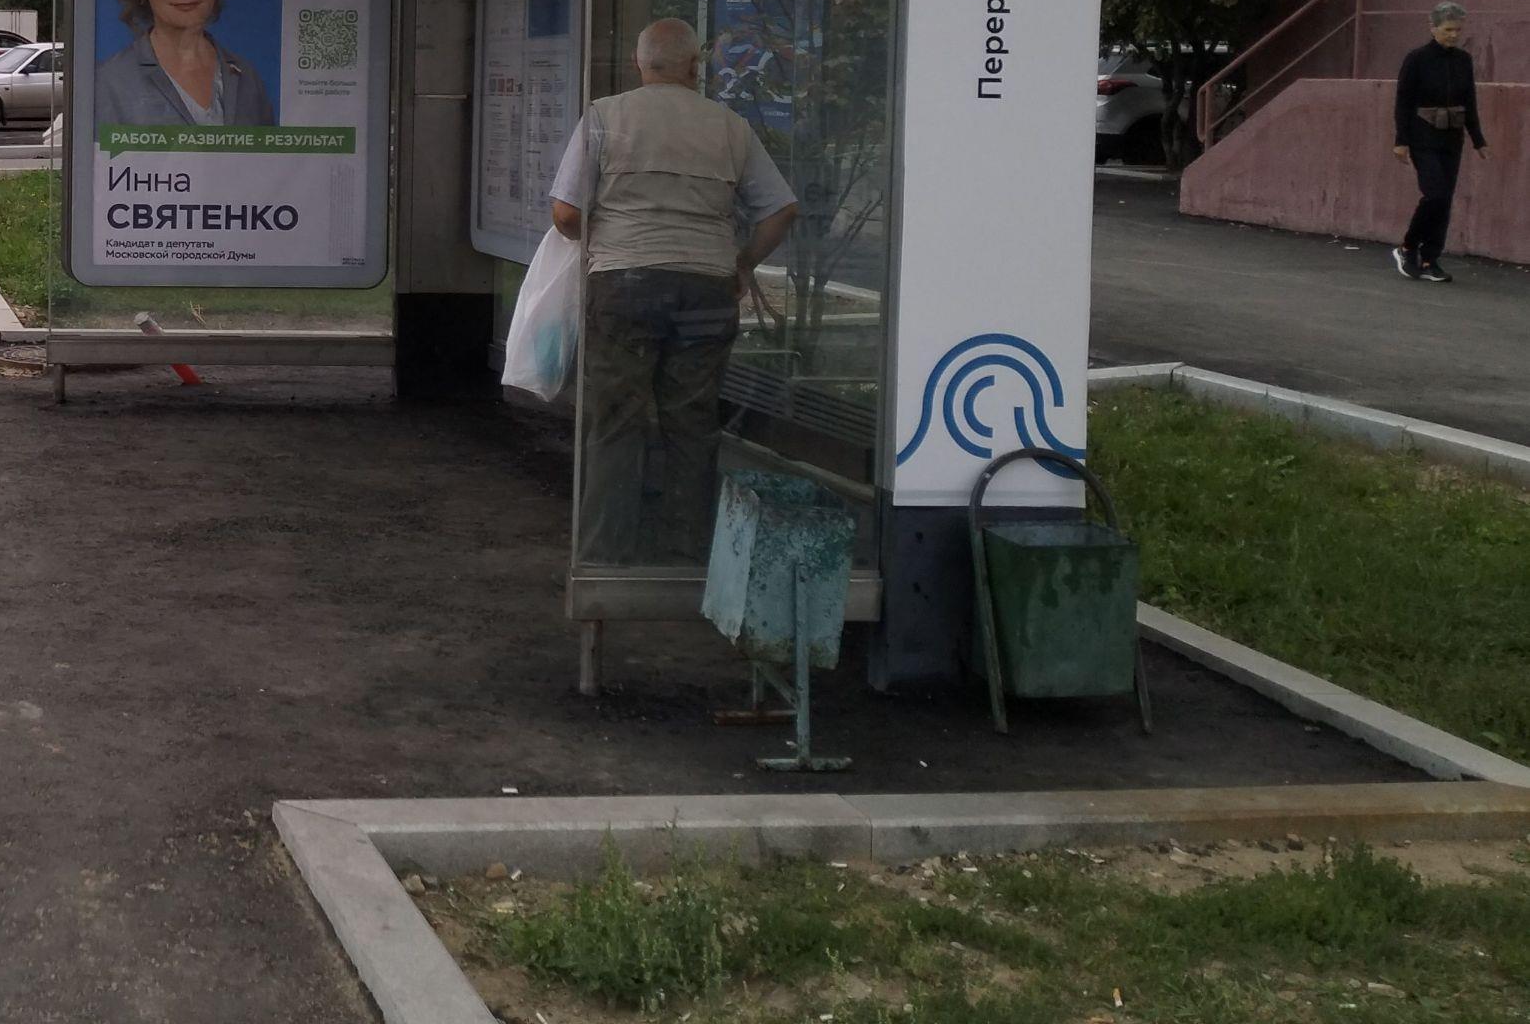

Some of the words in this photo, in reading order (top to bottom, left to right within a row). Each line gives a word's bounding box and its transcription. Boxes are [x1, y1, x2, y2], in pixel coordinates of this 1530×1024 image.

[111, 132, 167, 145] РАБОТА
[178, 133, 254, 146] РАЗВИТИЕ
[265, 134, 345, 147] РЕЗУЛЬТАТ
[107, 166, 191, 193] Инна
[107, 203, 299, 231] СВЯТЕНКО
[105, 239, 156, 249] Кандидат
[165, 241, 215, 250] депутаты
[105, 249, 169, 259] Московской
[171, 250, 226, 261] городской
[228, 250, 256, 261] Думы
